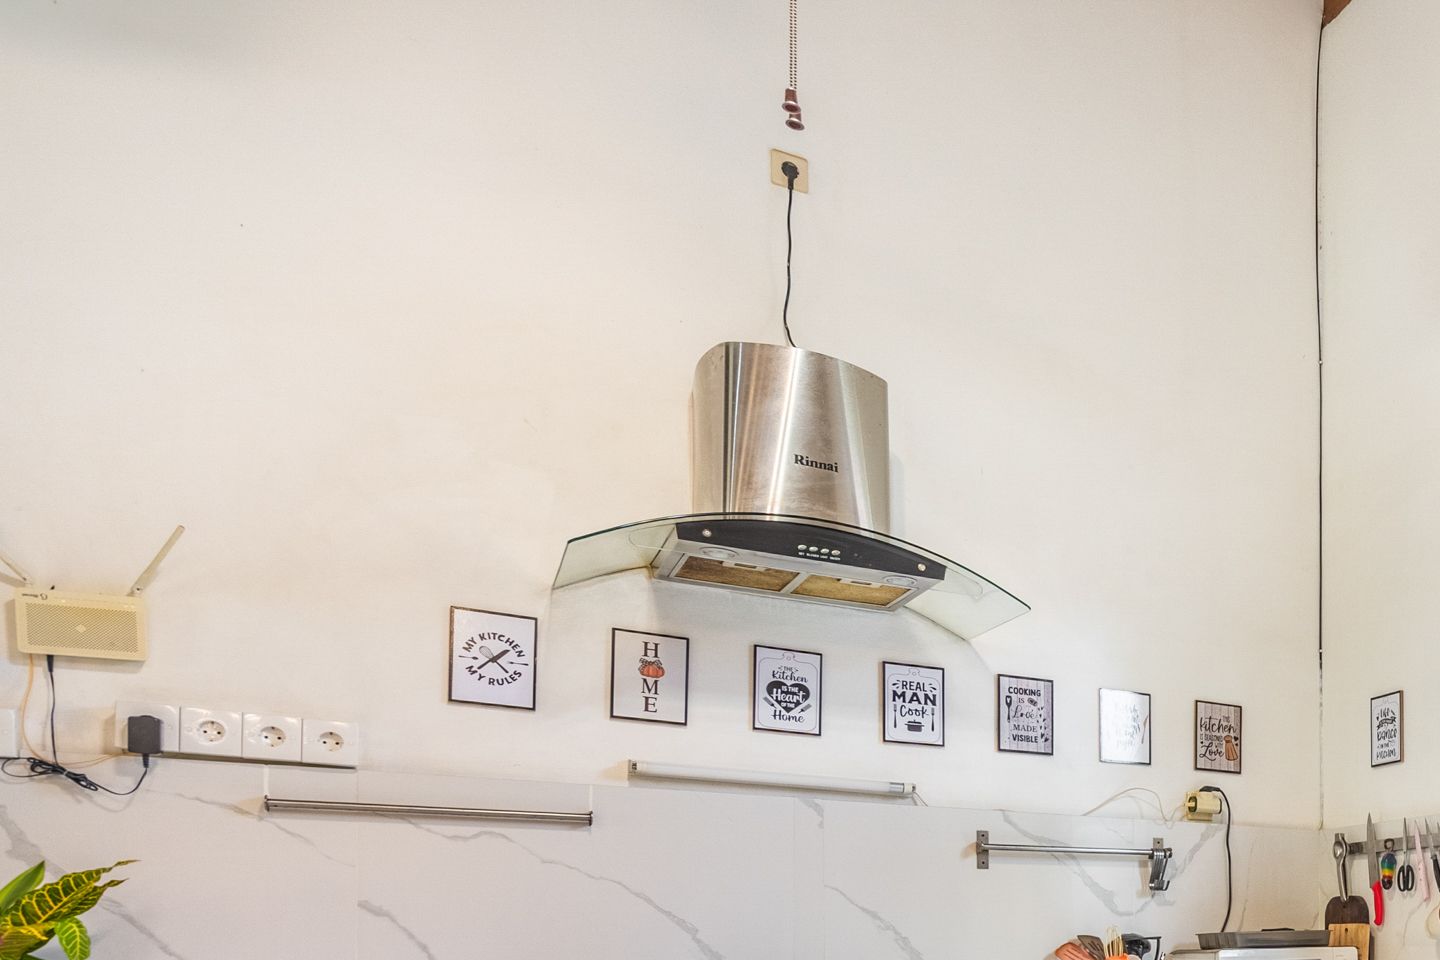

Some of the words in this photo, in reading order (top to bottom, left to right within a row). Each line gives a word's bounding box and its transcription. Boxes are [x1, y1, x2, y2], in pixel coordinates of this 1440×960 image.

[794, 453, 839, 473] Rinnai
[462, 637, 477, 653] MY
[478, 632, 526, 659] KITCHEN
[465, 664, 486, 682] MY
[488, 670, 523, 686] RULES
[772, 670, 808, 683] Kitchen
[902, 681, 927, 692] REAL
[1008, 686, 1041, 697] COOKING
[771, 688, 806, 703] Heart
[892, 690, 937, 706] MAN
[771, 709, 806, 723] Home
[900, 705, 929, 717] Cook
[1013, 724, 1037, 732] MADE
[1012, 734, 1038, 743] VISIBLE
[1199, 742, 1224, 761] Love
